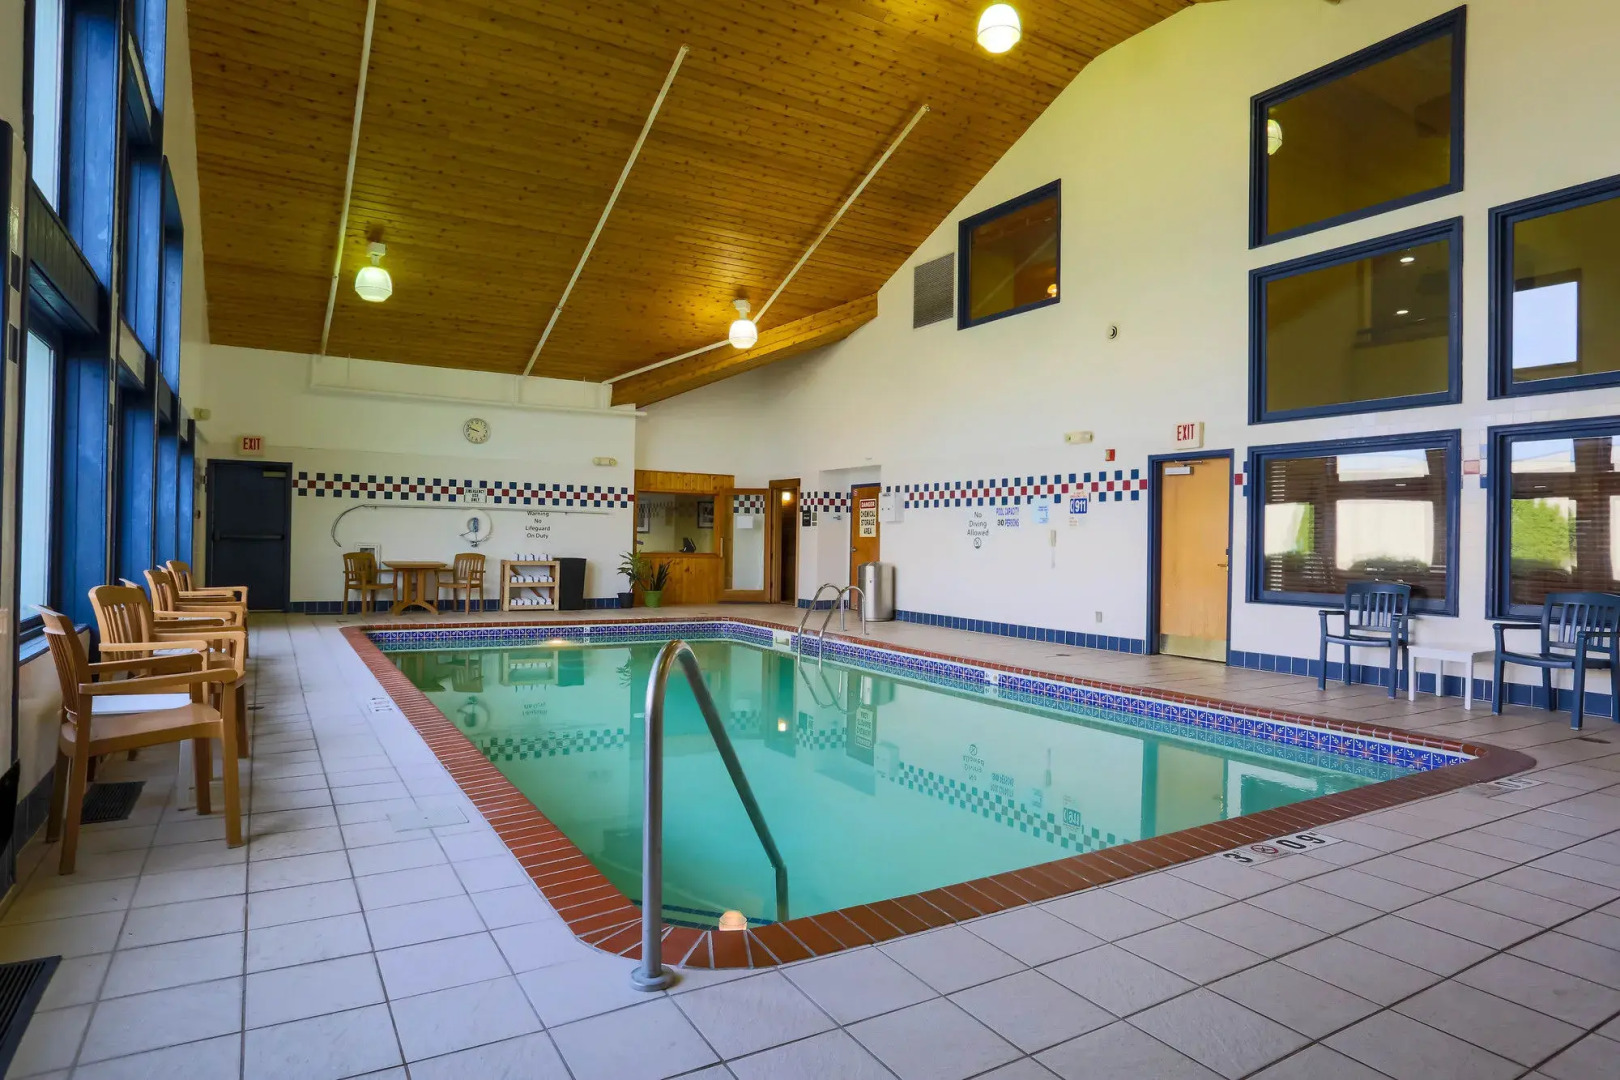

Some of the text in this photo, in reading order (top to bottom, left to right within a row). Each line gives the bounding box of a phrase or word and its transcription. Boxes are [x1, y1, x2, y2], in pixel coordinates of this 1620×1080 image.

[1177, 423, 1195, 441] EXIT
[243, 437, 261, 450] EXIT
[1074, 499, 1086, 513] 911
[969, 520, 987, 528] Diving
